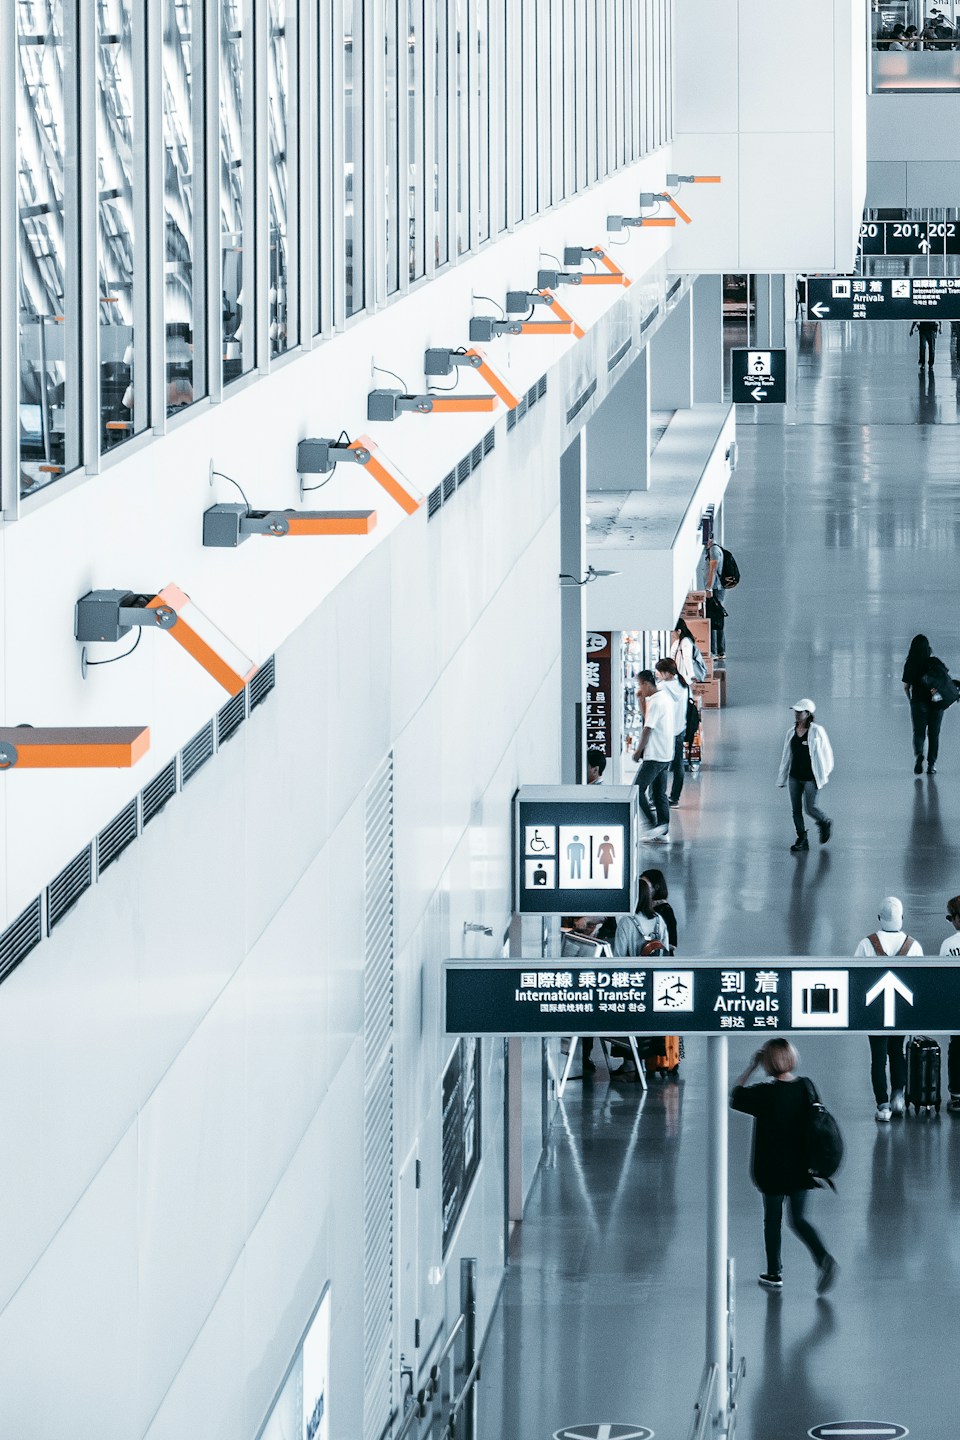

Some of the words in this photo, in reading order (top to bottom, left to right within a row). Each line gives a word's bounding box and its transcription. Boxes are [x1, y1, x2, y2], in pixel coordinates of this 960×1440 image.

[928, 223, 956, 237] 202
[853, 293, 885, 303] Arrivals
[520, 971, 573, 988] 国際線
[578, 971, 646, 988] 乗り継ぎ
[515, 989, 593, 1001] International
[596, 988, 646, 1001] Transfer
[713, 995, 779, 1012] Arrivals
[720, 1016, 745, 1028] 到达
[753, 1016, 779, 1028] 도착
